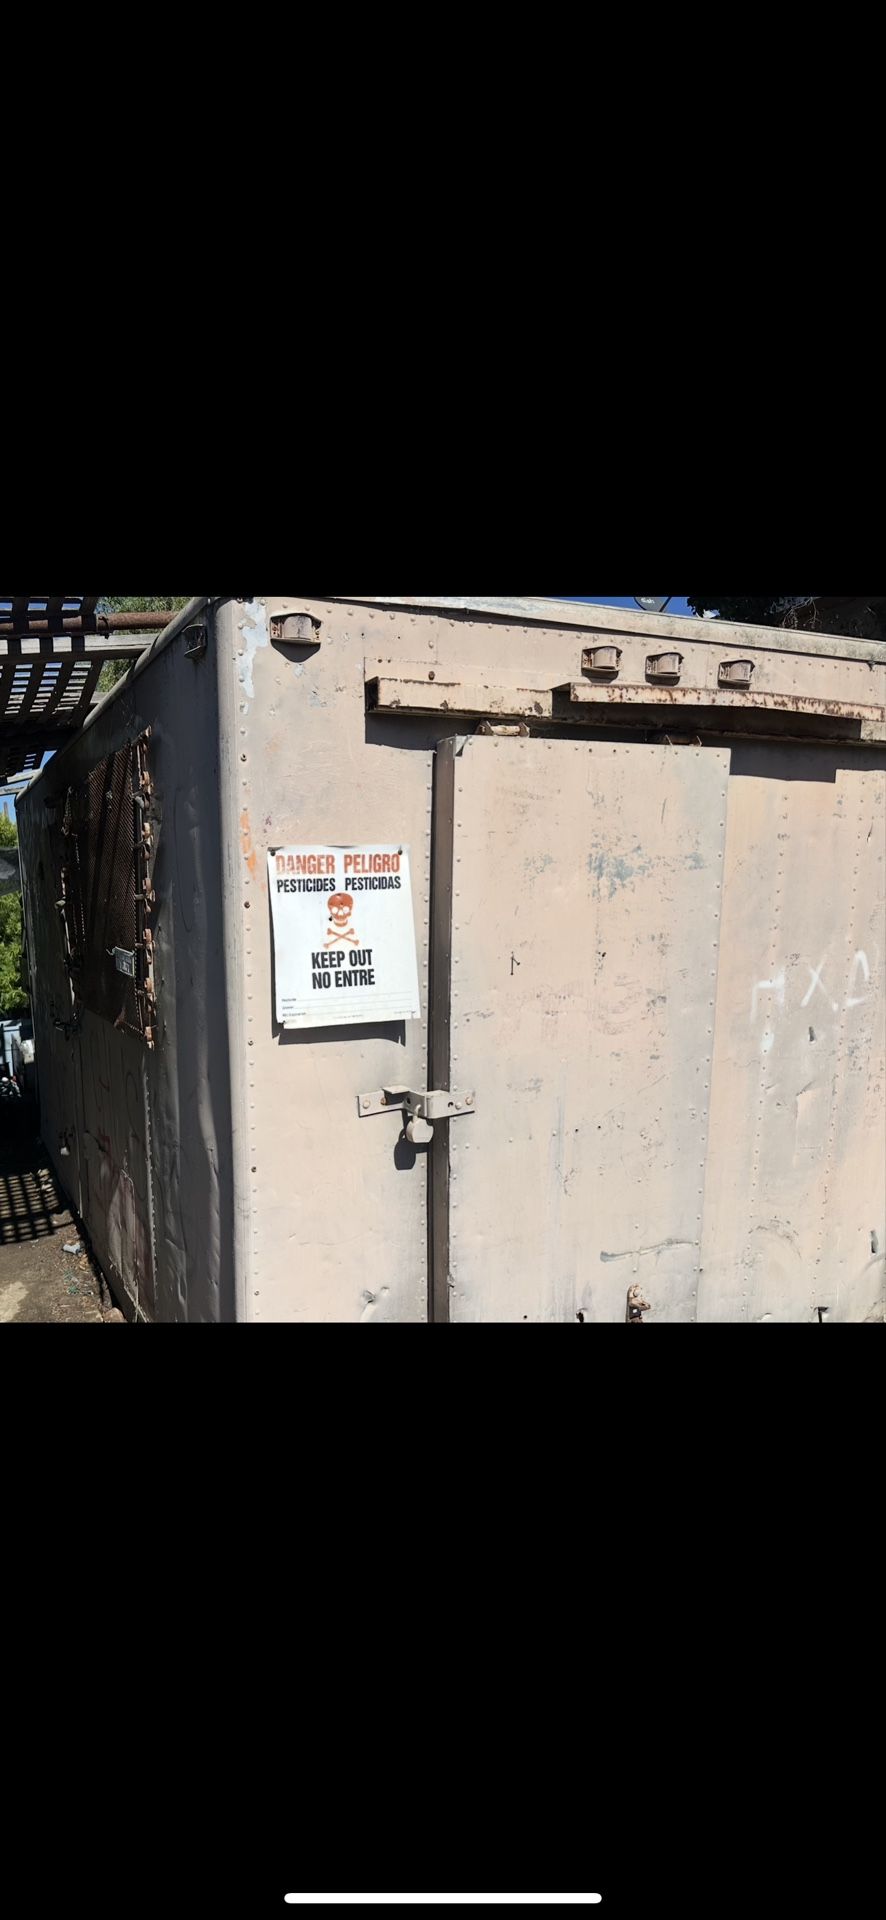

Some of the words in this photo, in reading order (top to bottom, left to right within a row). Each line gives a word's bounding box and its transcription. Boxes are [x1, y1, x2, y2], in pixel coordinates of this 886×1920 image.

[275, 854, 336, 875] DANGER
[343, 853, 401, 874] PELIGRO
[276, 878, 336, 893] PESTICIDES
[344, 876, 402, 892] PESTICIDAS
[311, 950, 345, 970] KEEP
[348, 949, 373, 967] OUT
[312, 971, 332, 990] NO
[335, 968, 376, 988] ENTRE
